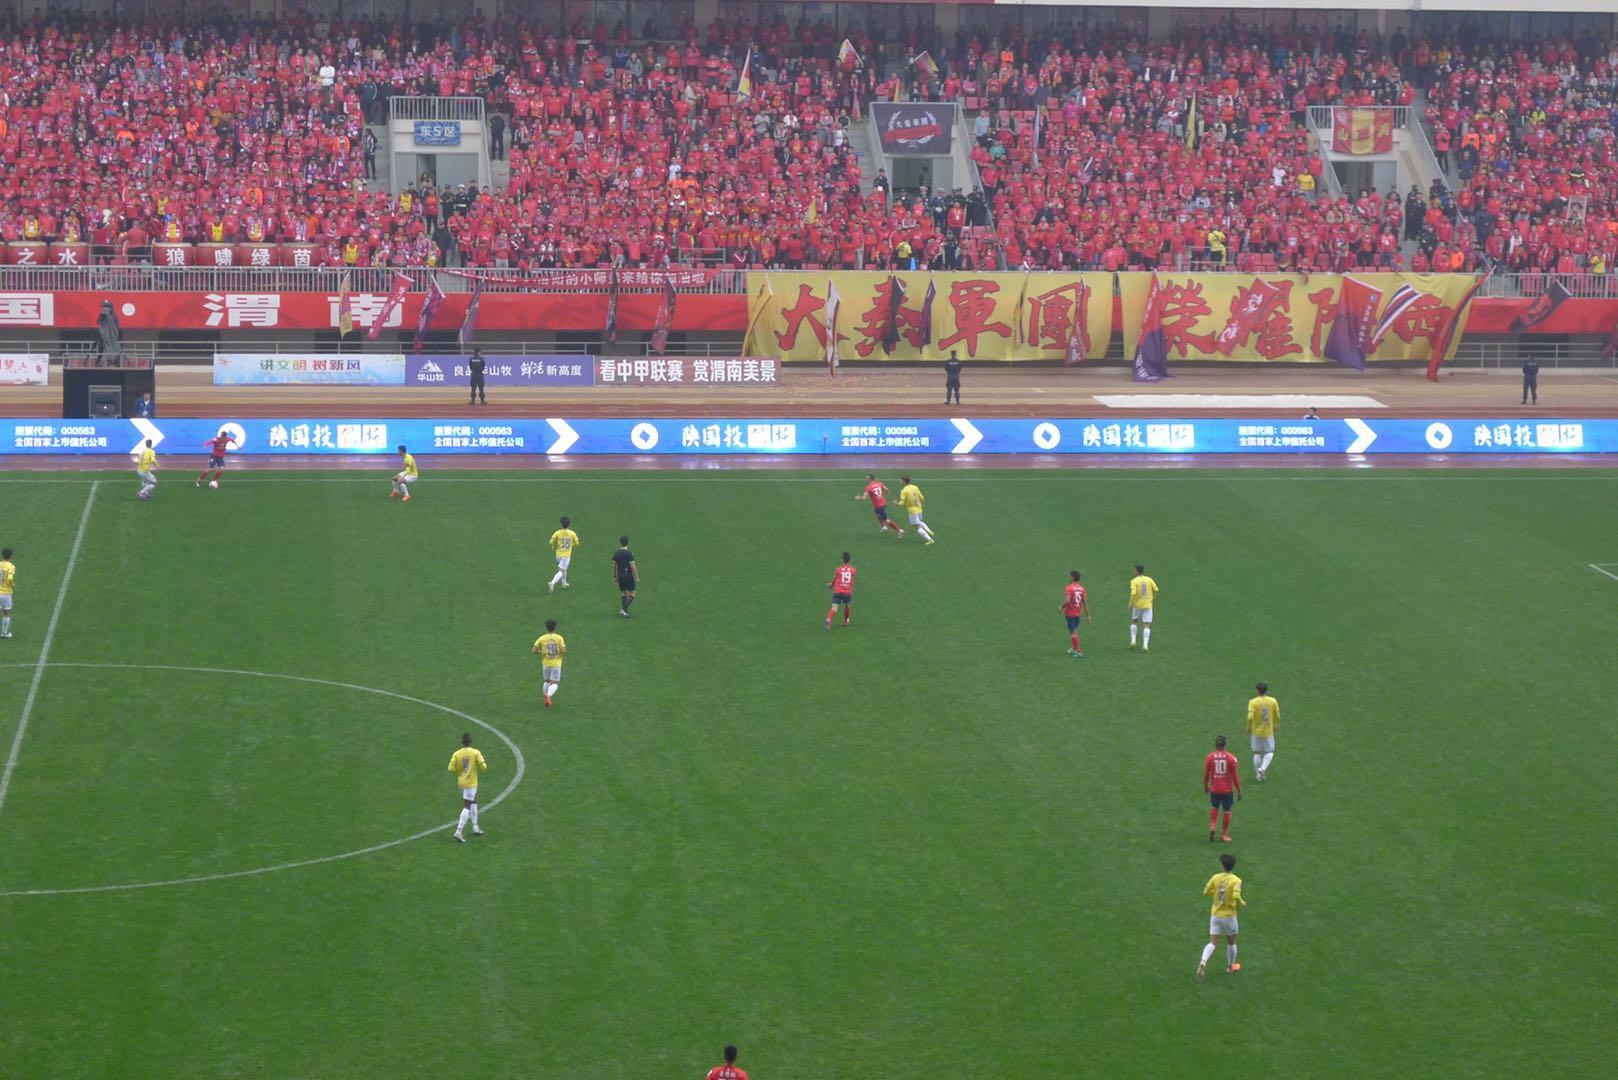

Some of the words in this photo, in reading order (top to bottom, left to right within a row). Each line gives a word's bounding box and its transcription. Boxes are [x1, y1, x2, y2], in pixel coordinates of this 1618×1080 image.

[419, 125, 455, 138] 东5区
[600, 359, 684, 382] 看中甲联赛
[693, 359, 776, 382] 赏渭南美景
[840, 571, 851, 584] 19
[1213, 759, 1227, 775] 10
